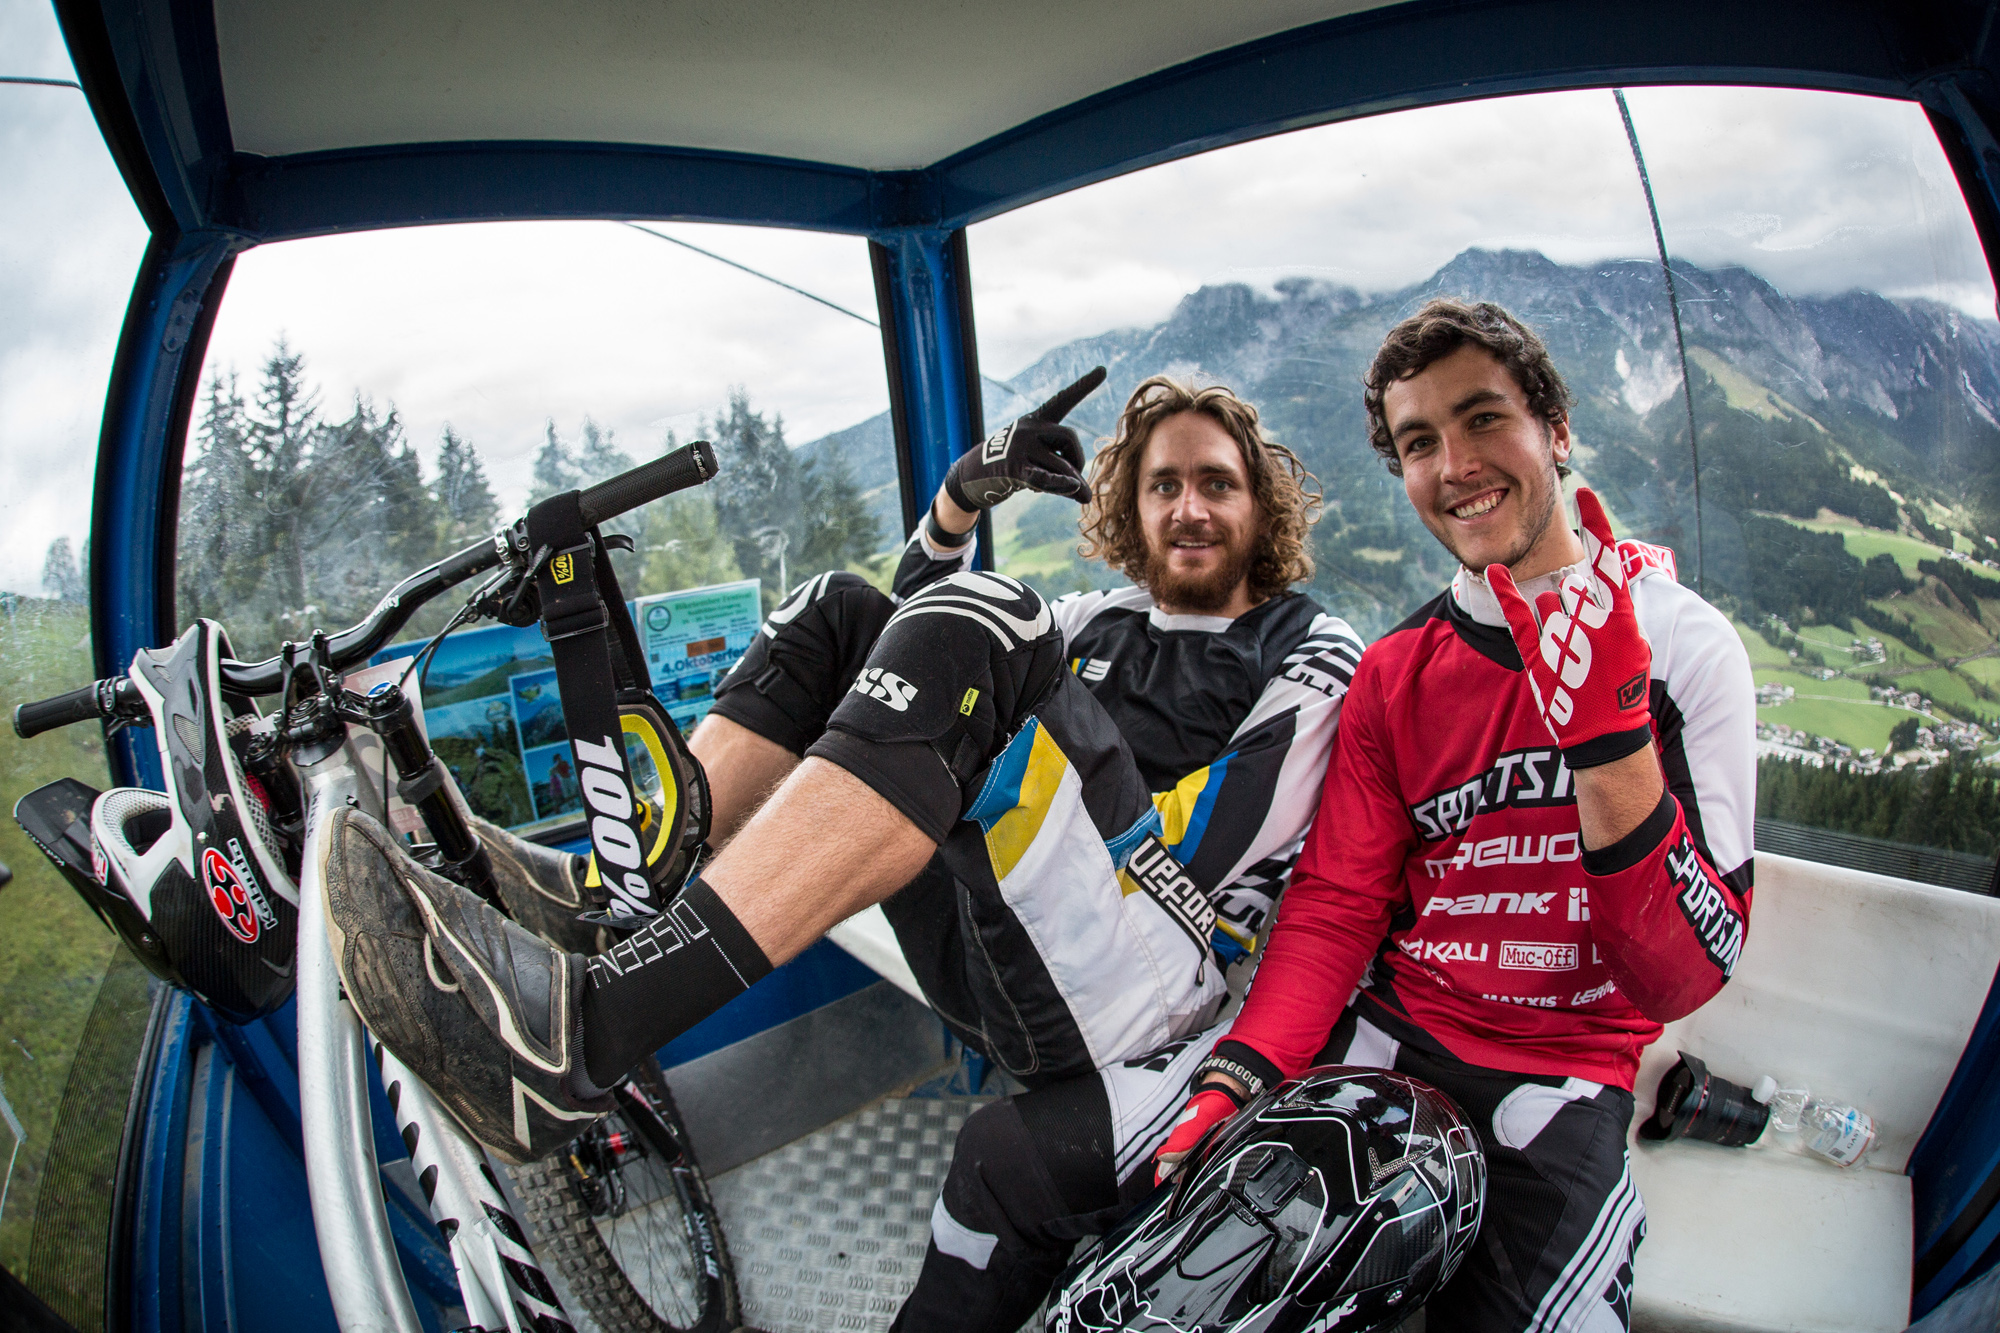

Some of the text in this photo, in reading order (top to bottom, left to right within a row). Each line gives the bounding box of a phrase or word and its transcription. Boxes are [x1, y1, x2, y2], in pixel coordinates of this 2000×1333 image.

[574, 735, 659, 918] 100%
[227, 837, 278, 930] Kabuto
[1424, 941, 1488, 964] KALI
[1504, 946, 1573, 968] Muc-Off
